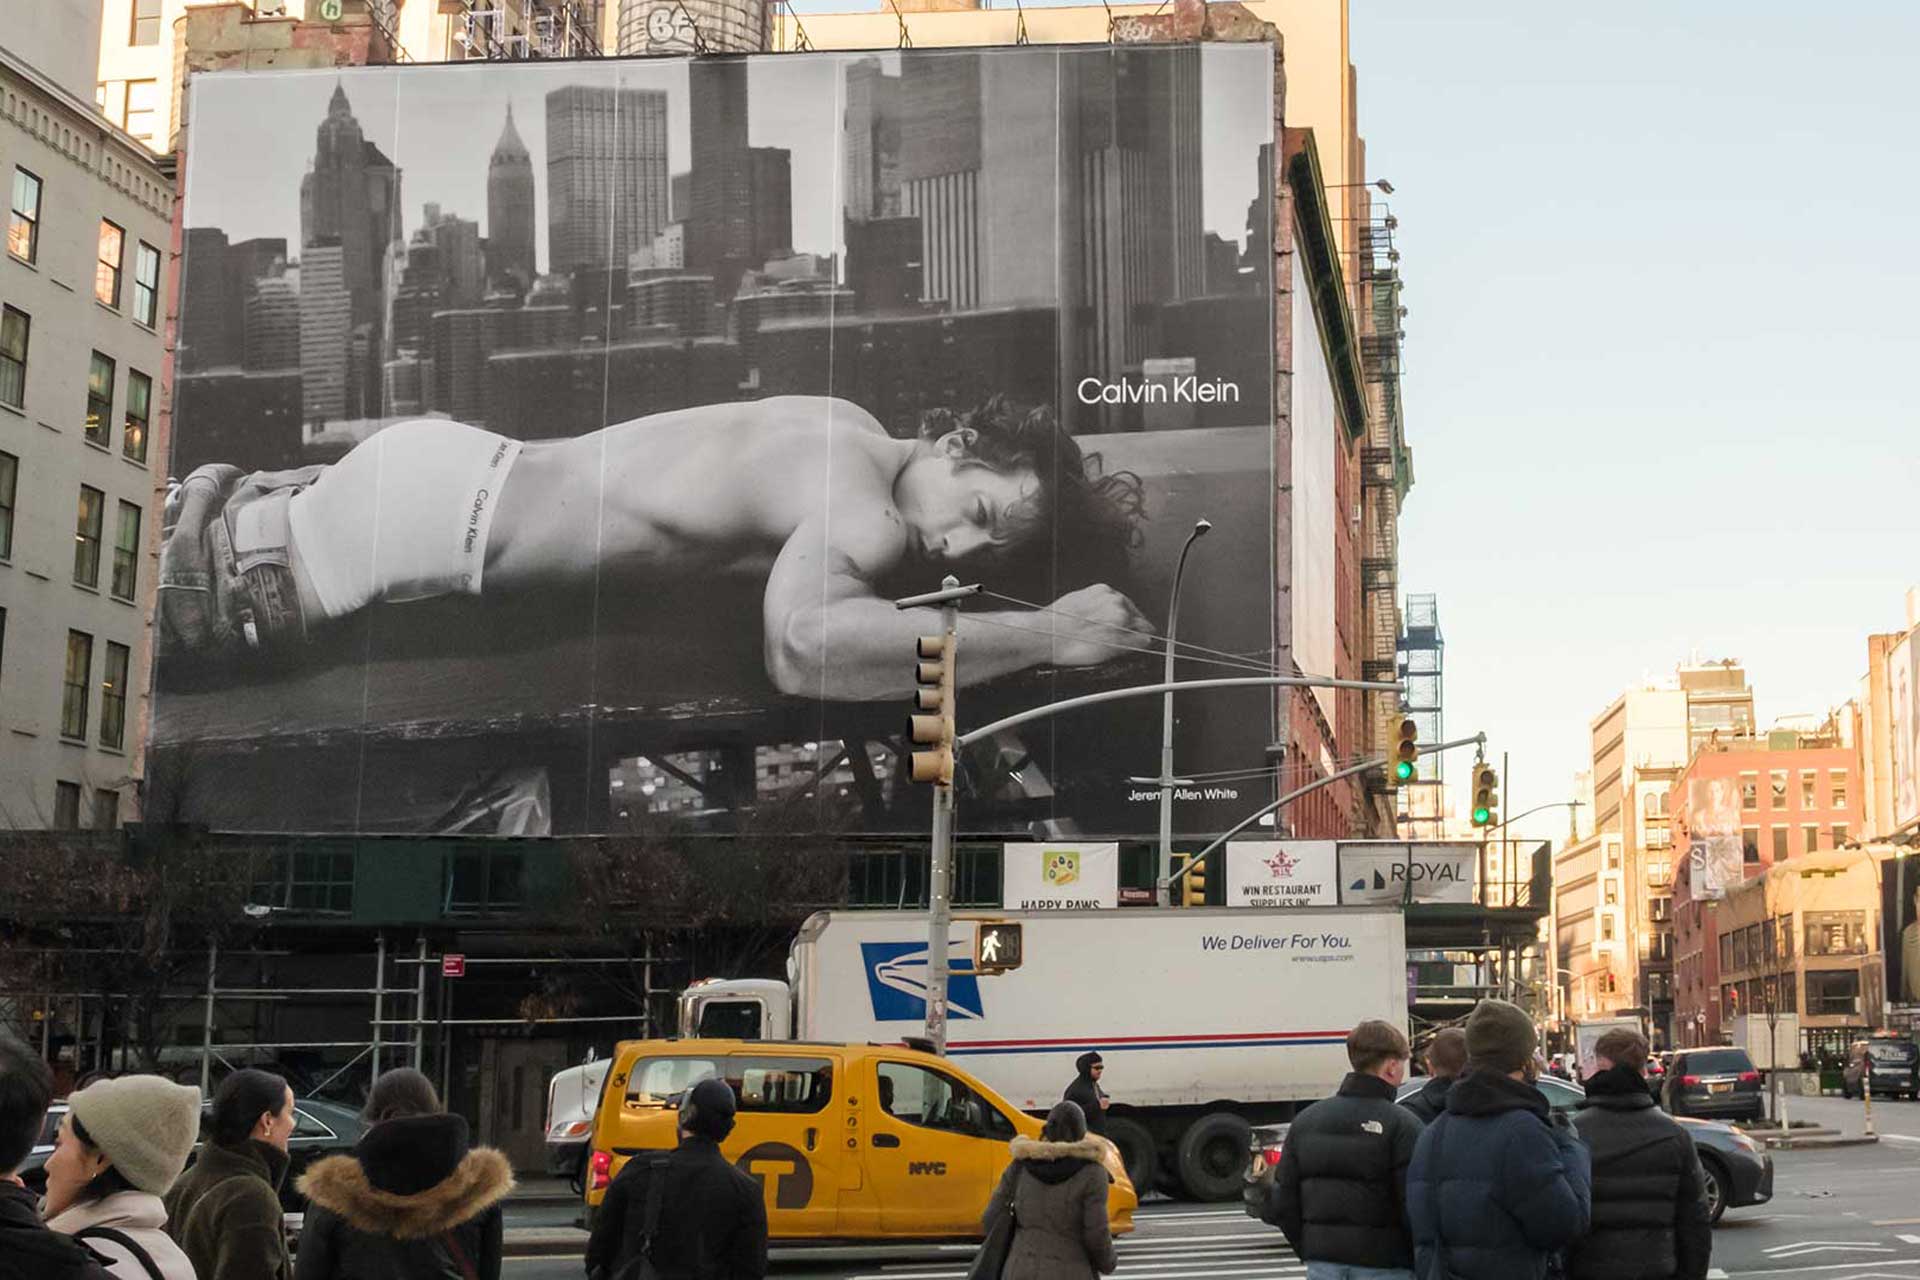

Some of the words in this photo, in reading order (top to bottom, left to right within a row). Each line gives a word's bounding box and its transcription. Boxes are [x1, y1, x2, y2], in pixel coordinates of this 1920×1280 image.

[1077, 376, 1168, 405] Calvin
[1173, 375, 1240, 404] Klein
[470, 488, 489, 525] Calvin
[464, 526, 478, 554] Klein
[1173, 788, 1202, 800] Allen
[1204, 788, 1238, 800] White
[1391, 862, 1467, 882] ROYAL
[1242, 885, 1260, 896] WIN
[1262, 884, 1322, 896] RESTAURANT
[1021, 900, 1063, 909] HAPPY
[1066, 899, 1100, 909] PAWS
[1250, 898, 1294, 907] SUPPLIES
[1202, 935, 1227, 950] We
[1231, 934, 1288, 950] Deliver
[1291, 934, 1318, 948] For
[1321, 933, 1352, 948] You.
[908, 1161, 947, 1176] NYC
